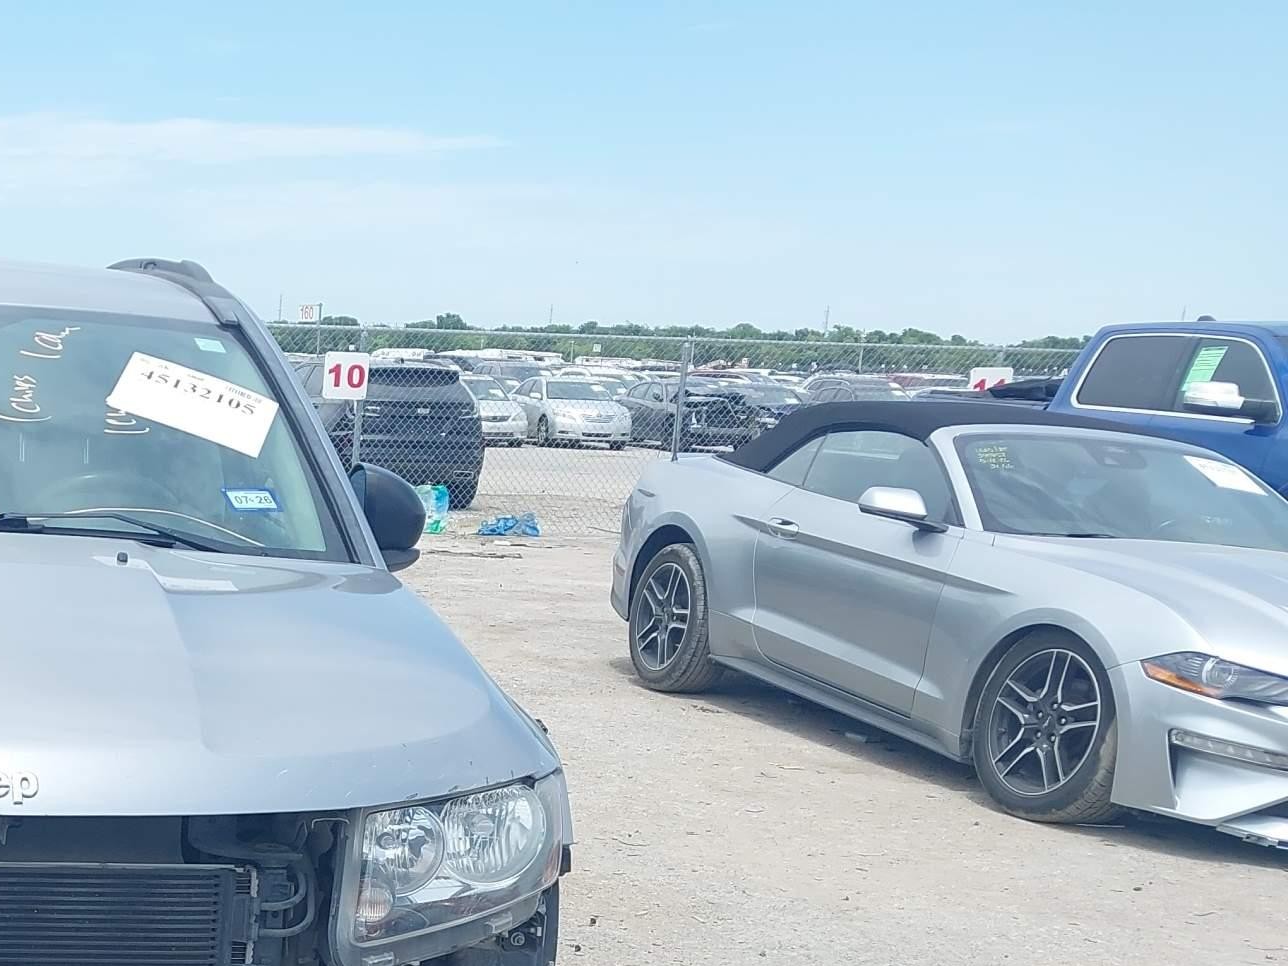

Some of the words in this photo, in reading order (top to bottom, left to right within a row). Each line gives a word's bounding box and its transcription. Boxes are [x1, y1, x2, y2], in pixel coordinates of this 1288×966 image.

[300, 306, 313, 320] 160
[328, 364, 365, 388] 10
[141, 371, 256, 416] 45132105
